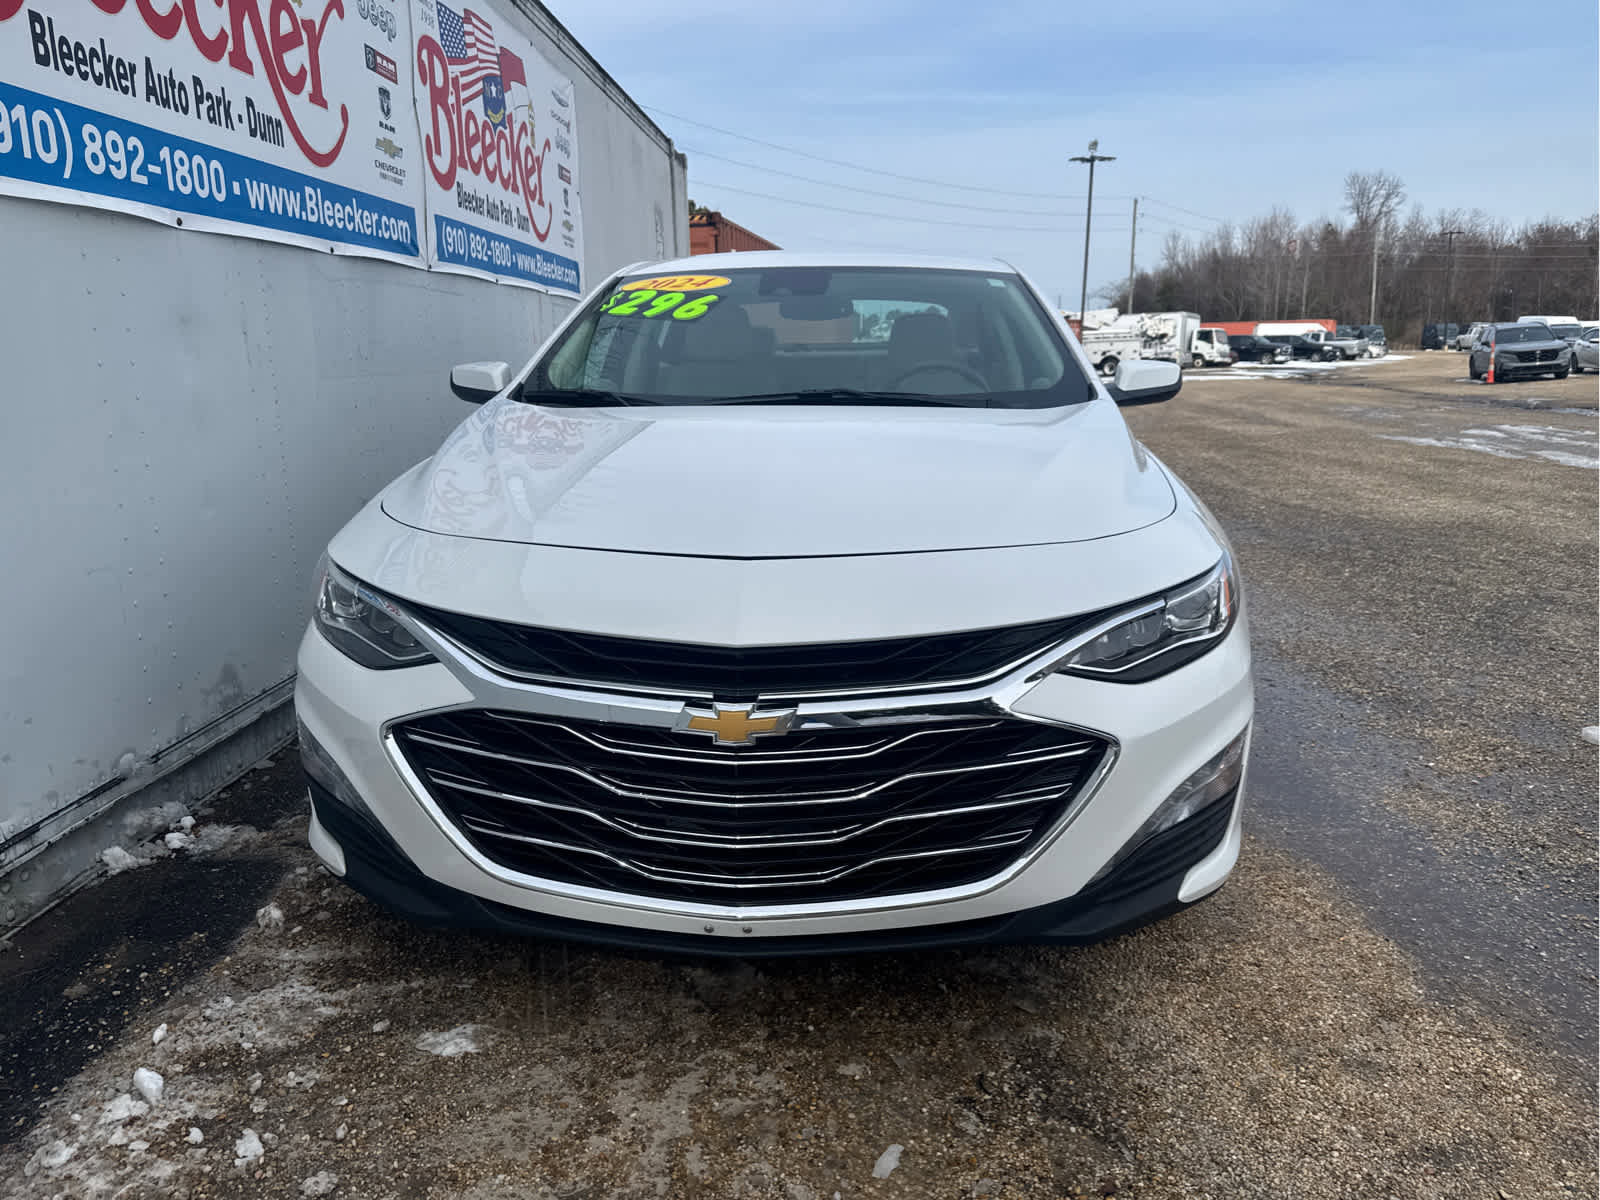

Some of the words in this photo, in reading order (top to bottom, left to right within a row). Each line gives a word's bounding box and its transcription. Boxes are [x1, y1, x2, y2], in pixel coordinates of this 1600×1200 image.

[27, 9, 137, 98] Bleecker
[144, 56, 189, 117] Auto
[192, 75, 235, 132] Park
[245, 96, 285, 148] Dunn
[379, 120, 395, 134] RAM
[417, 34, 552, 242] Bleecker
[81, 123, 226, 202] 892-1800
[244, 178, 411, 244] www.Bleecker.com
[375, 159, 406, 178] CHEVROLET
[456, 180, 485, 217] Bleecker
[486, 193, 500, 223] Auto
[500, 199, 513, 228] Park
[516, 206, 530, 234] Dunn
[442, 221, 468, 262] (910)
[470, 232, 511, 267] 892-1800
[517, 252, 577, 285] www.Bleecker.com
[600, 290, 719, 319] $296
